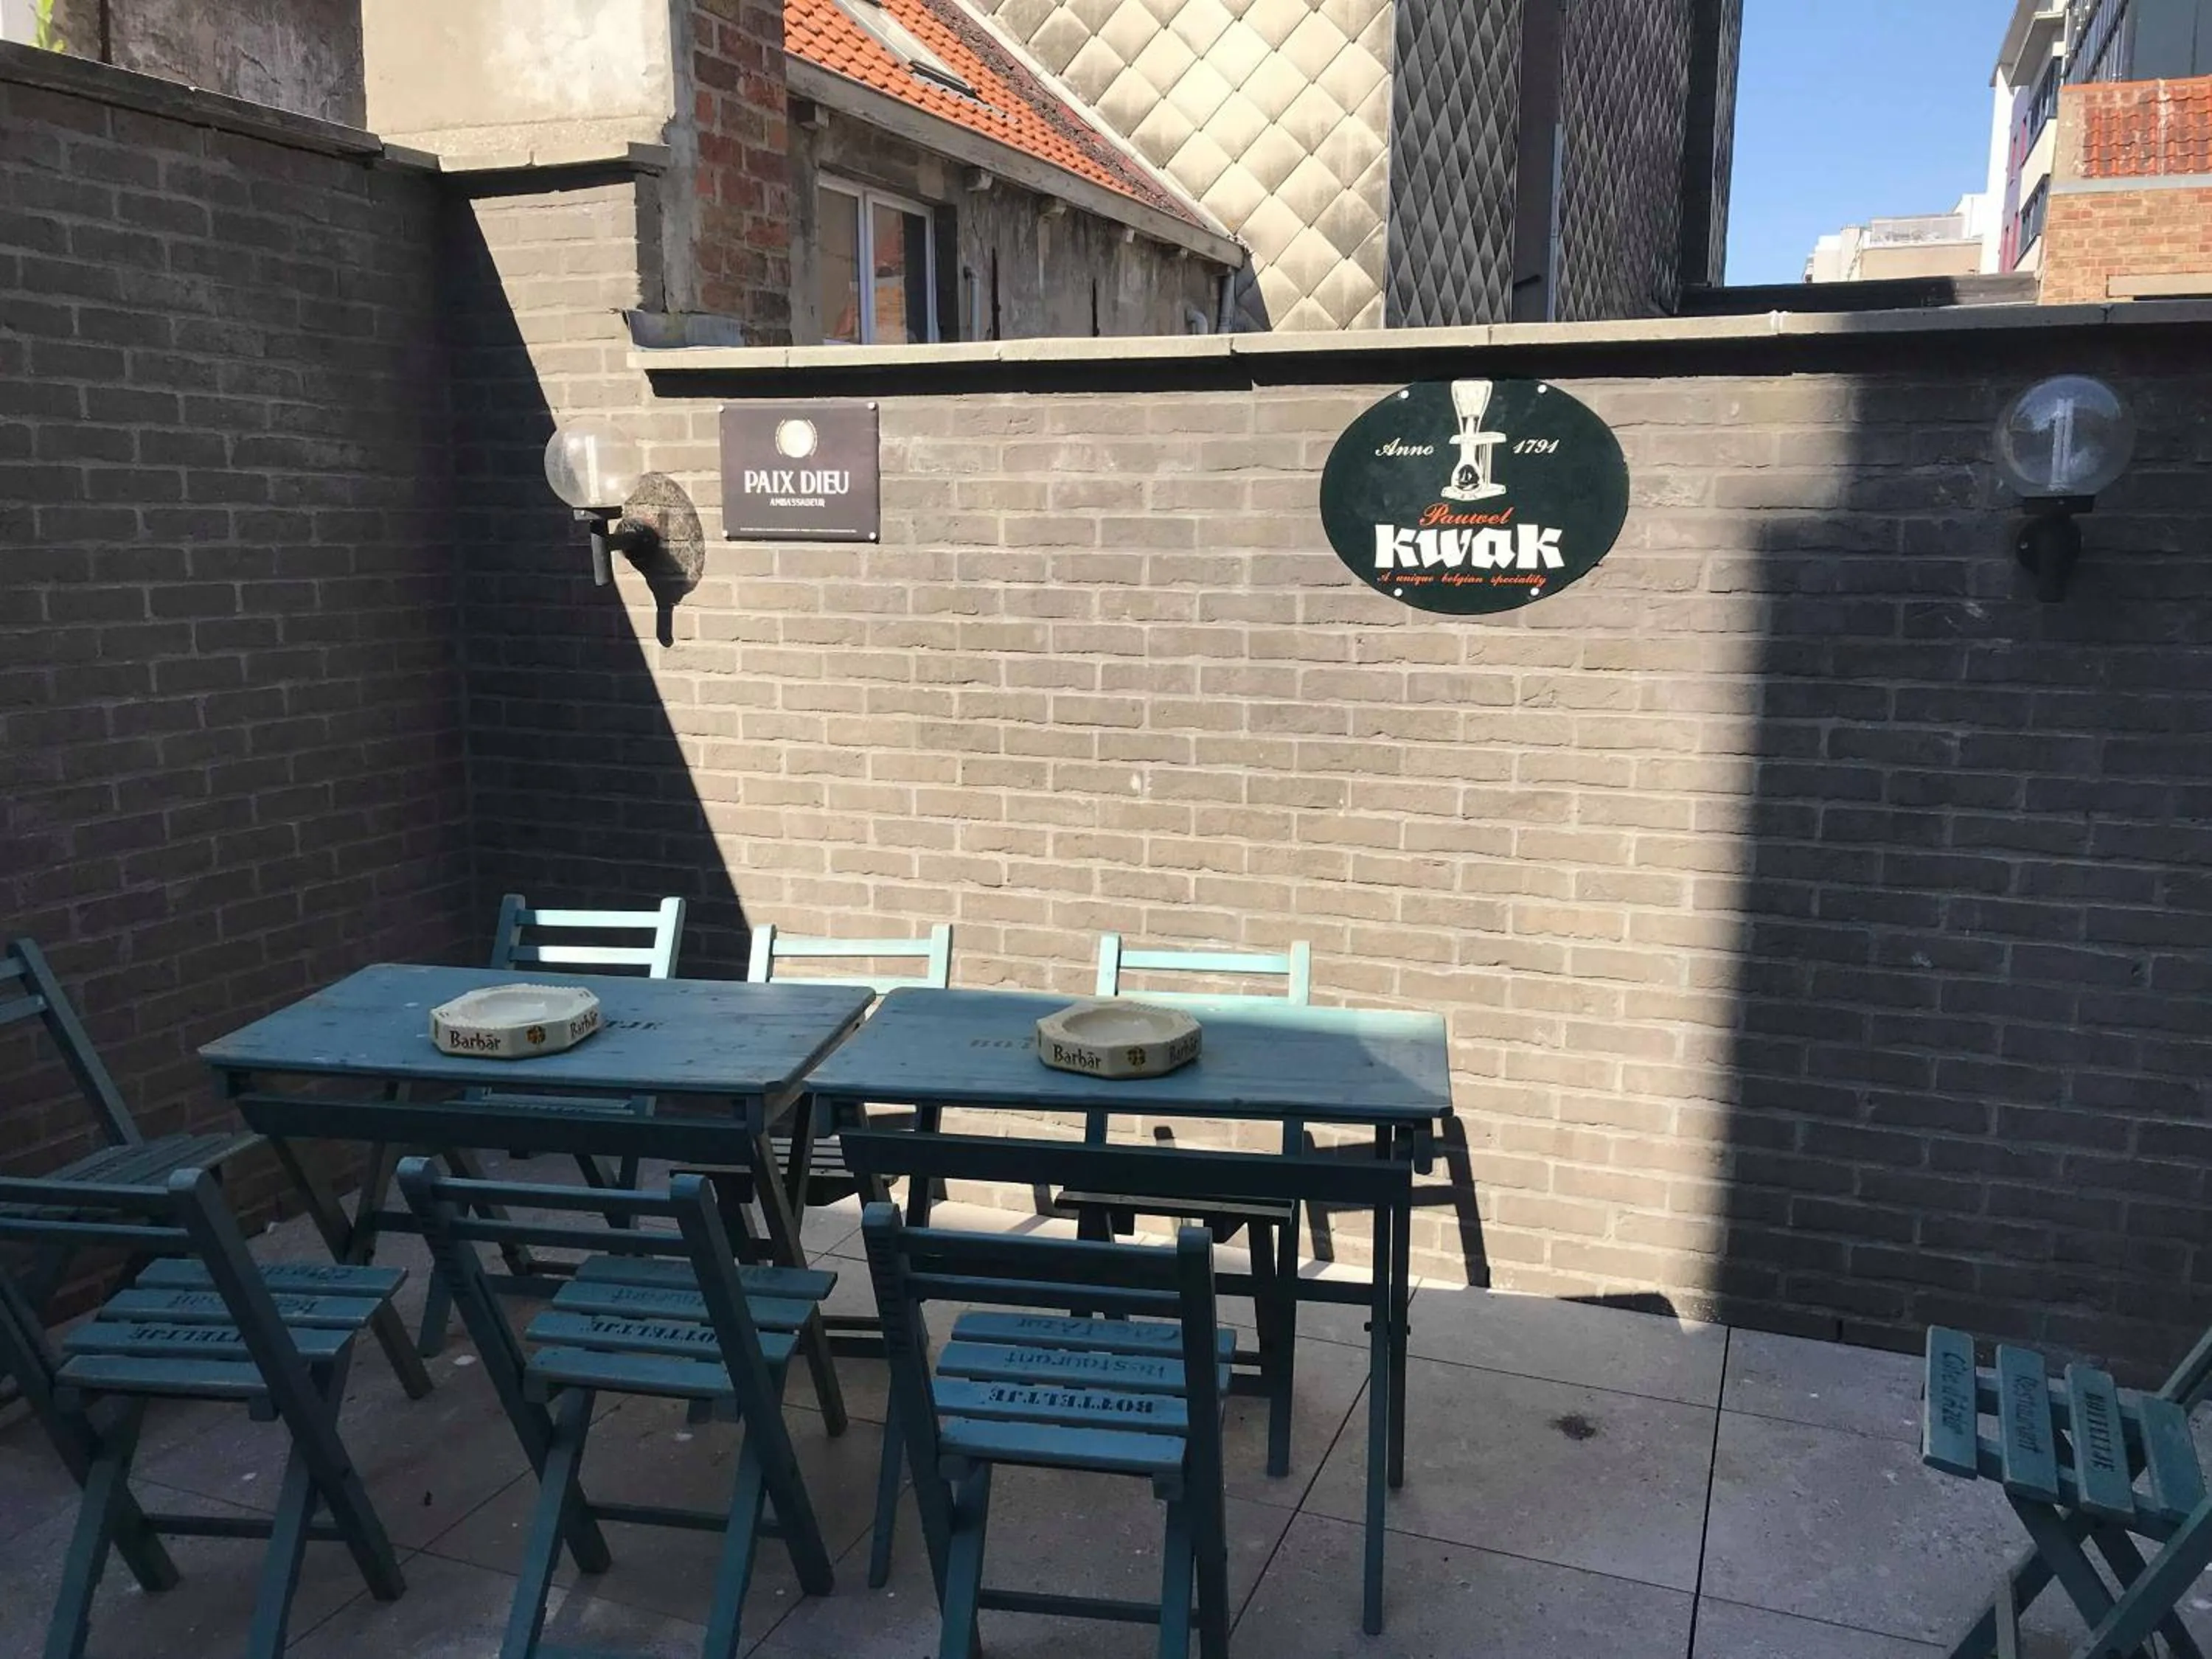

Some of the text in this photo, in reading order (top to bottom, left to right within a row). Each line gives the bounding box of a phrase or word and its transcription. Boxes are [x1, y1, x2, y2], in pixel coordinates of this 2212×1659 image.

[1375, 437, 1561, 457] Anno 1791
[744, 470, 850, 495] PAIX DIEU
[769, 498, 825, 508] AMBASSADEUR
[1419, 502, 1516, 526] Pauwel
[1395, 573, 1434, 586] unique
[1441, 572, 1484, 588] belgian
[1489, 572, 1547, 588] speciality
